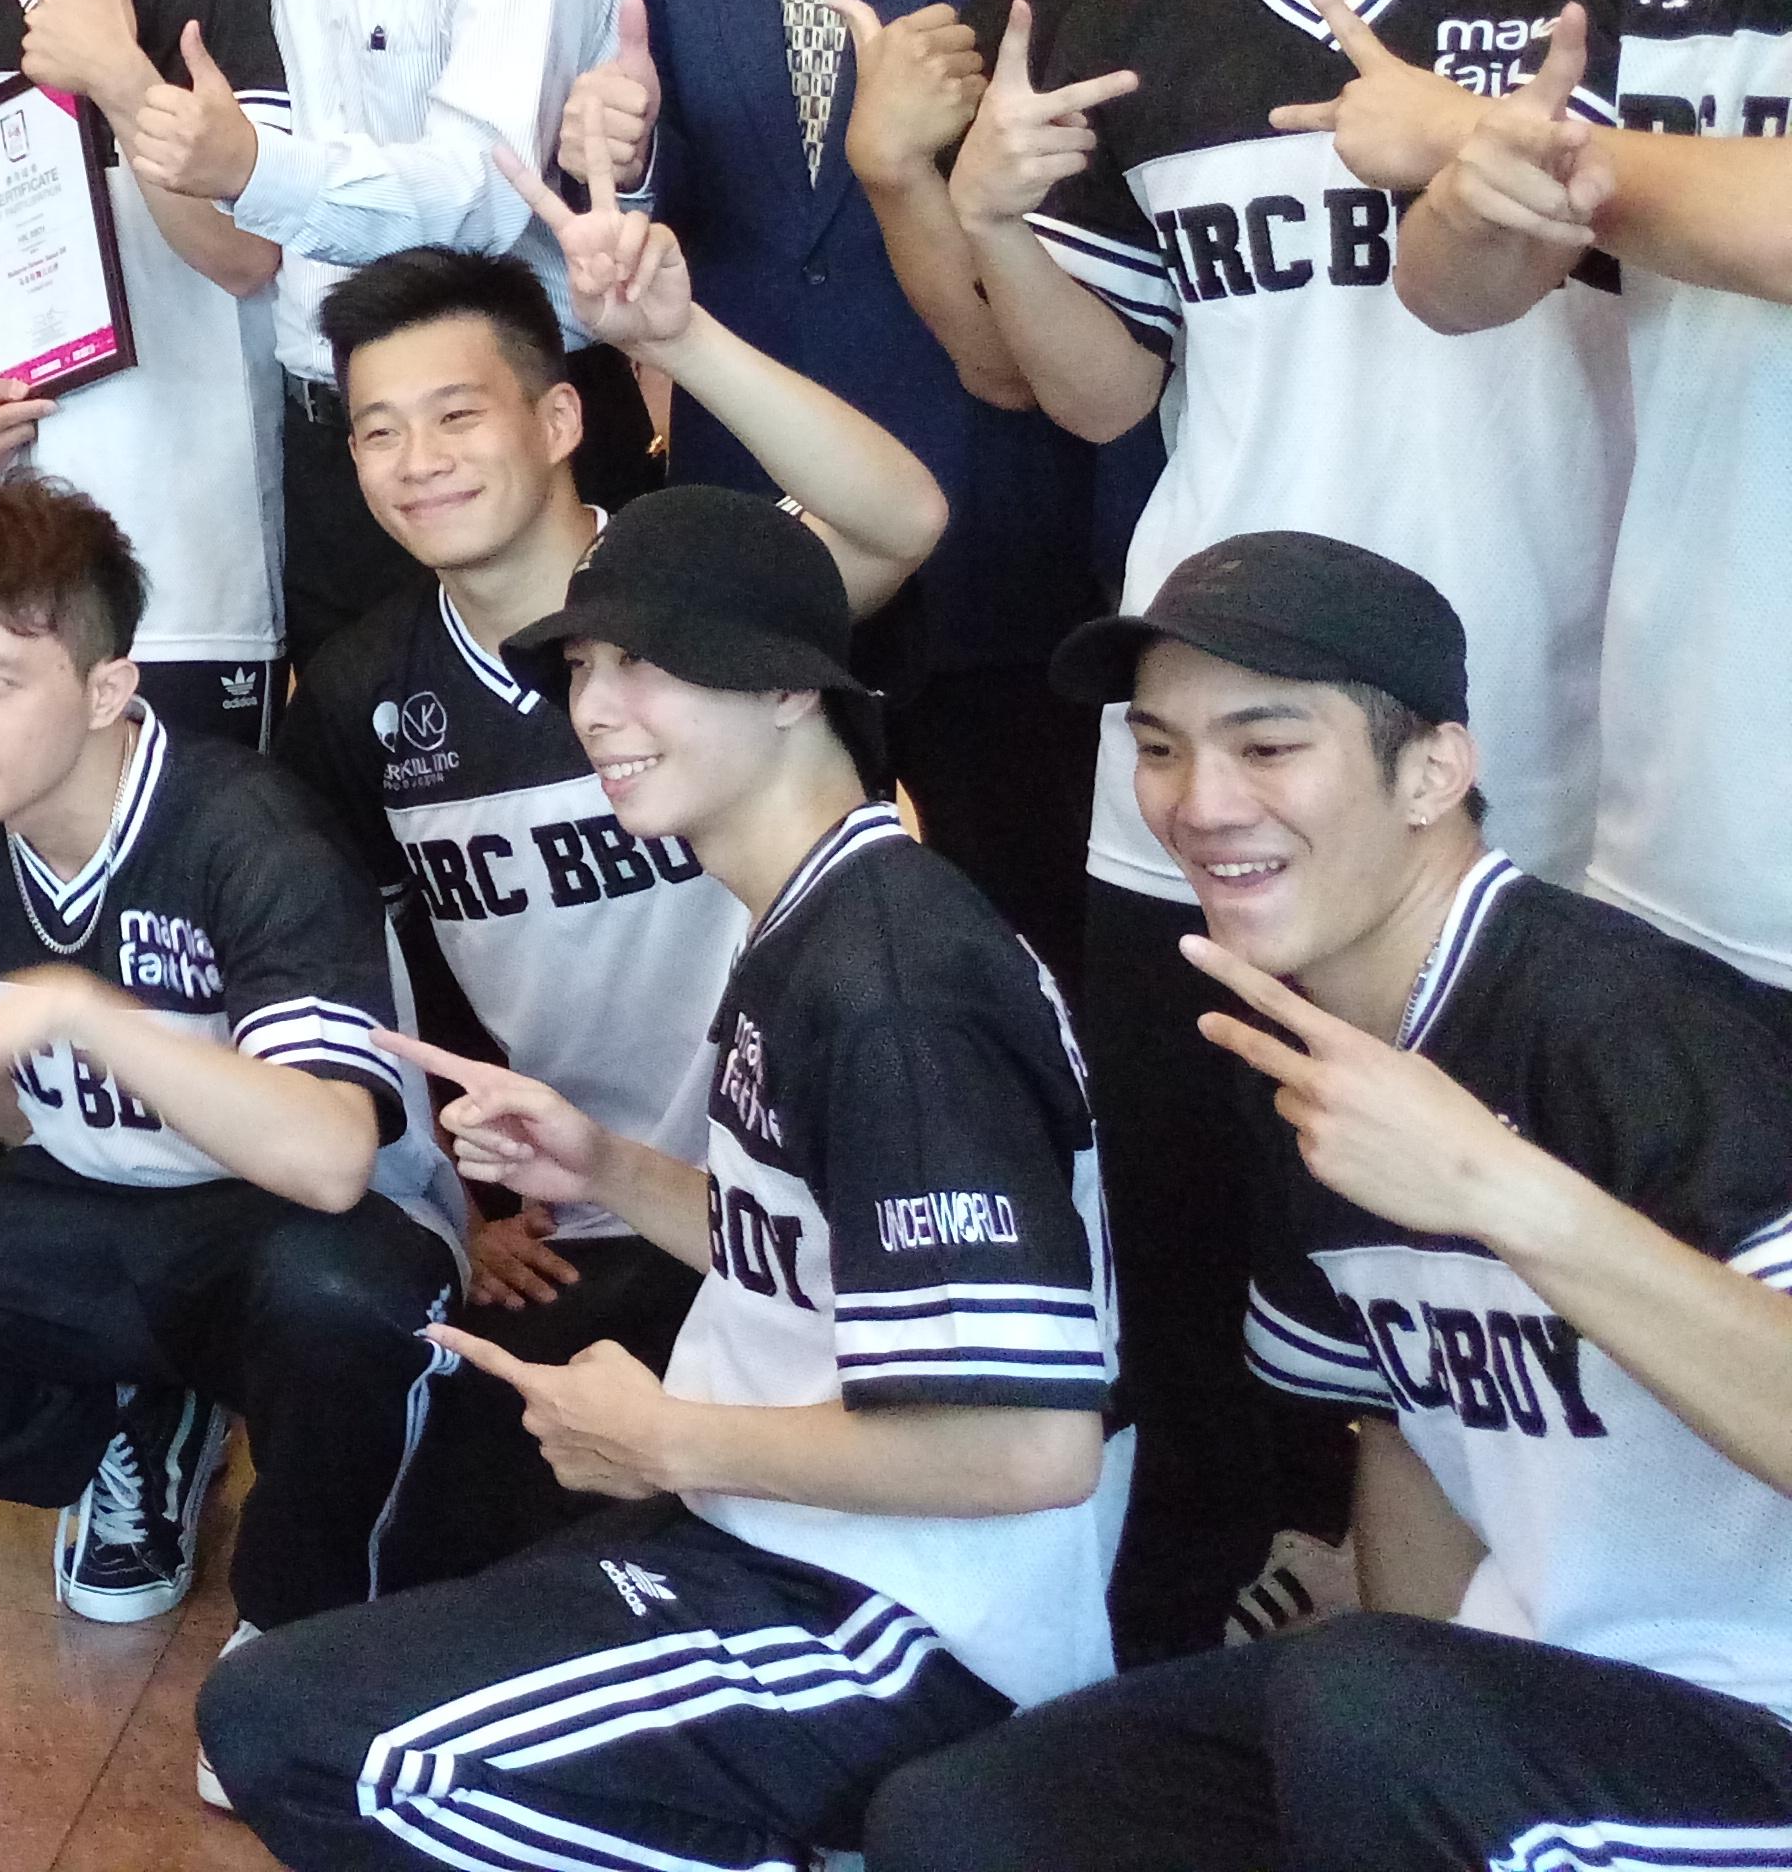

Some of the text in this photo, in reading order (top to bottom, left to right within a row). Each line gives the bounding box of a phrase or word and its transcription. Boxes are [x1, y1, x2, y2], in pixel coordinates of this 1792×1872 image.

[529, 814, 704, 908] BBO
[120, 910, 215, 959] mania
[600, 1559, 647, 1617] adidas
